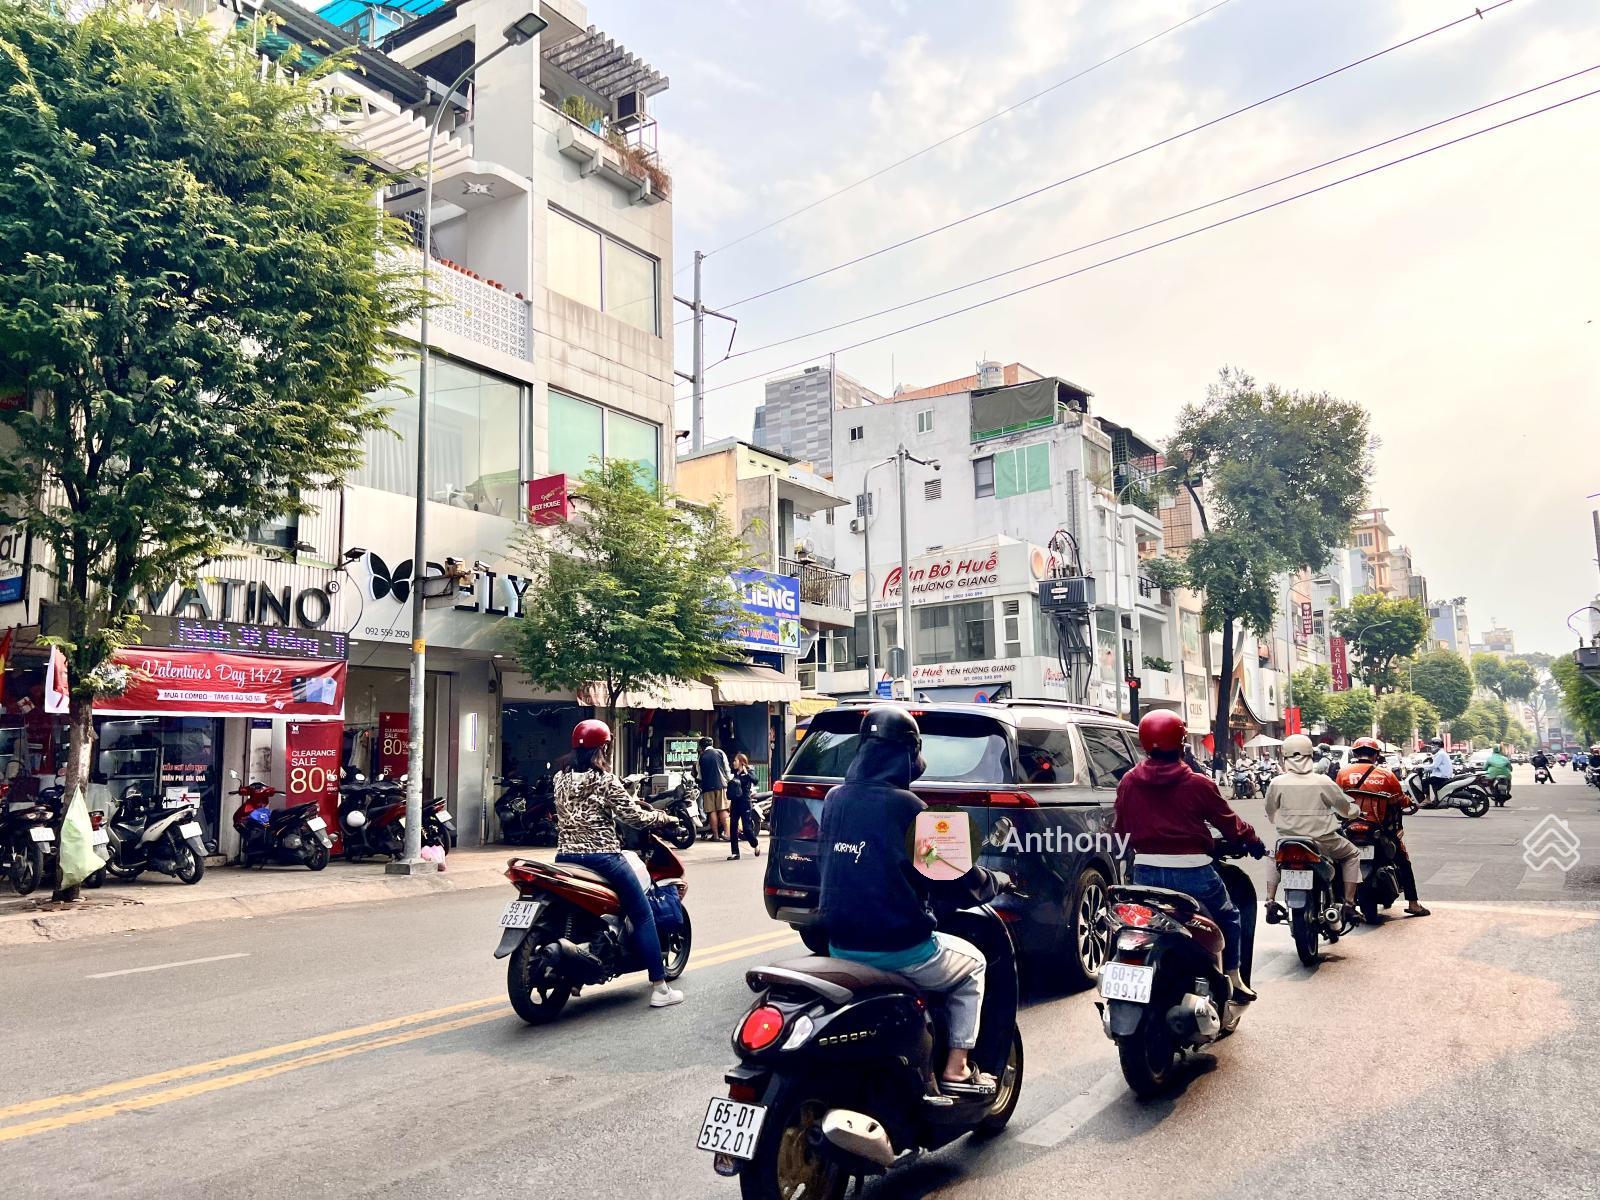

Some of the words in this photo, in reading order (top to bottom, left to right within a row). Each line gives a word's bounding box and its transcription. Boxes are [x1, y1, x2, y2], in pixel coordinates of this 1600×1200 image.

[928, 560, 951, 579] Bò
[956, 550, 997, 575] Huế
[957, 574, 998, 588] GIANG
[365, 627, 379, 636] 092
[141, 660, 211, 680] Valentine's
[214, 664, 246, 688] Day
[249, 668, 282, 684] 14/2
[922, 665, 943, 677] Huế
[991, 664, 1016, 673] GIANG
[184, 693, 207, 701] COMBO
[291, 758, 317, 767] SALE
[833, 841, 866, 863] NORMAL?
[701, 1124, 754, 1155] 552.01
